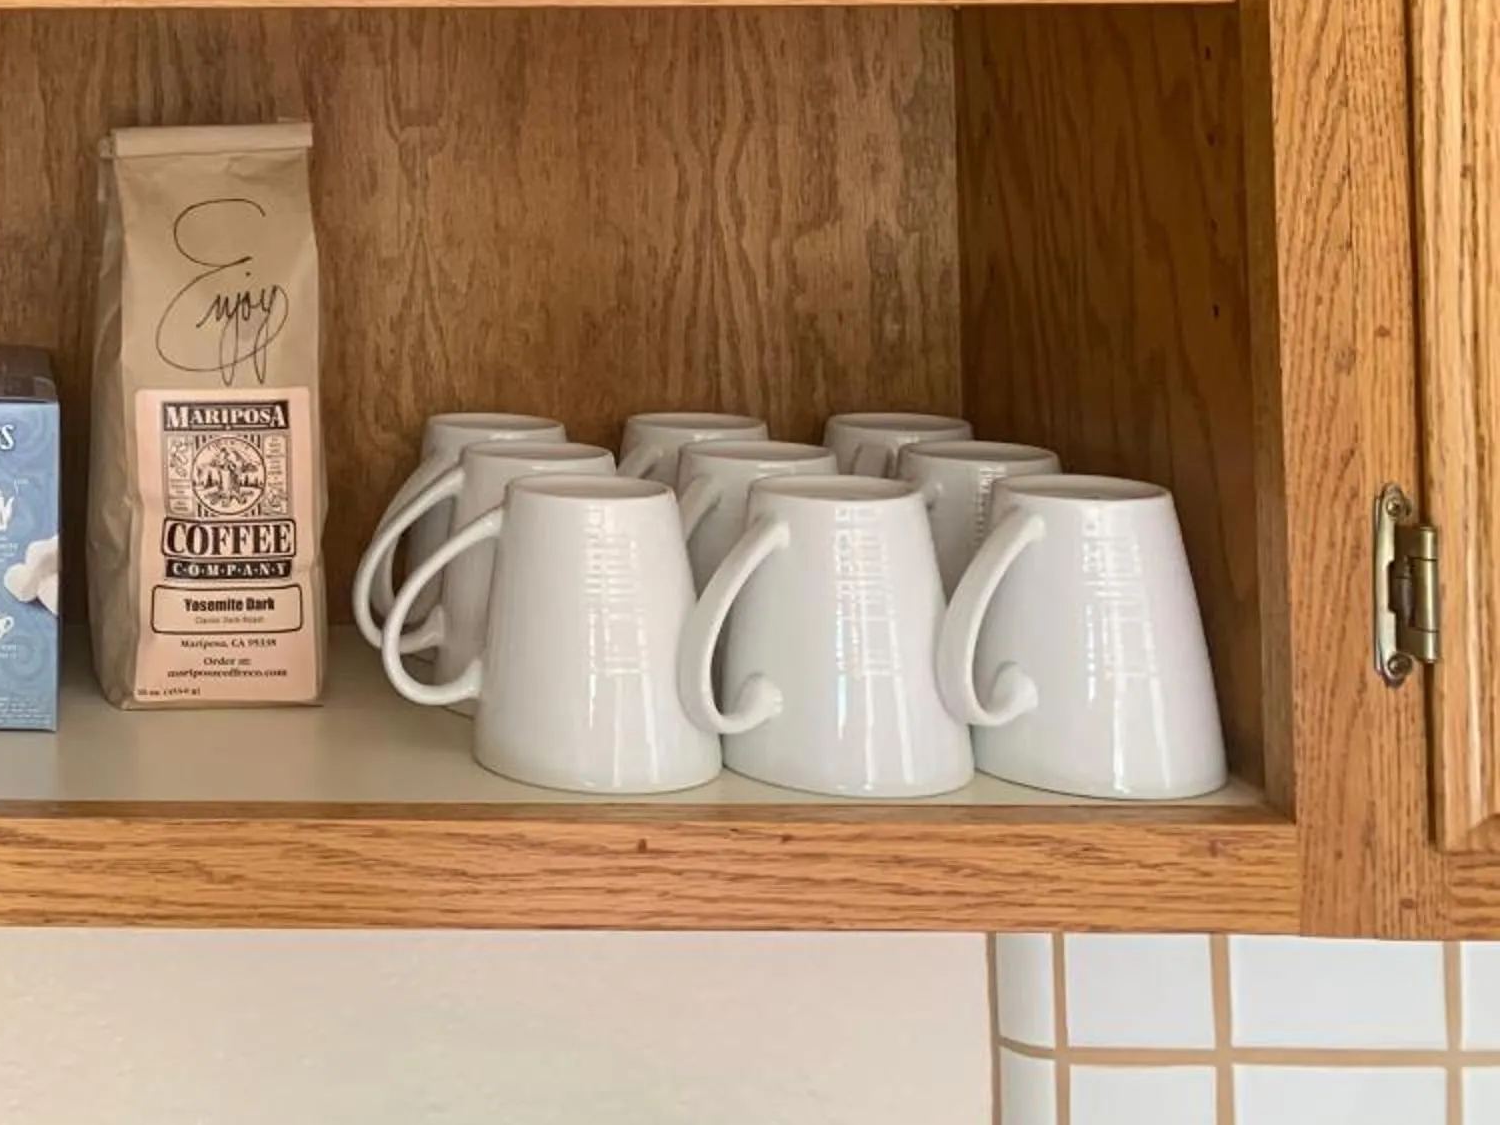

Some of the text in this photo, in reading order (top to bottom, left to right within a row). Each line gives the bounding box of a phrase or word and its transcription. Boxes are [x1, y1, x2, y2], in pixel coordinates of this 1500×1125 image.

[156, 198, 289, 387] Enjoy
[166, 404, 287, 429] MARIPOSA
[166, 523, 292, 556] COFFEE
[183, 597, 275, 612] Yosemite Dark
[231, 638, 245, 648] CA
[203, 656, 236, 666] Order
